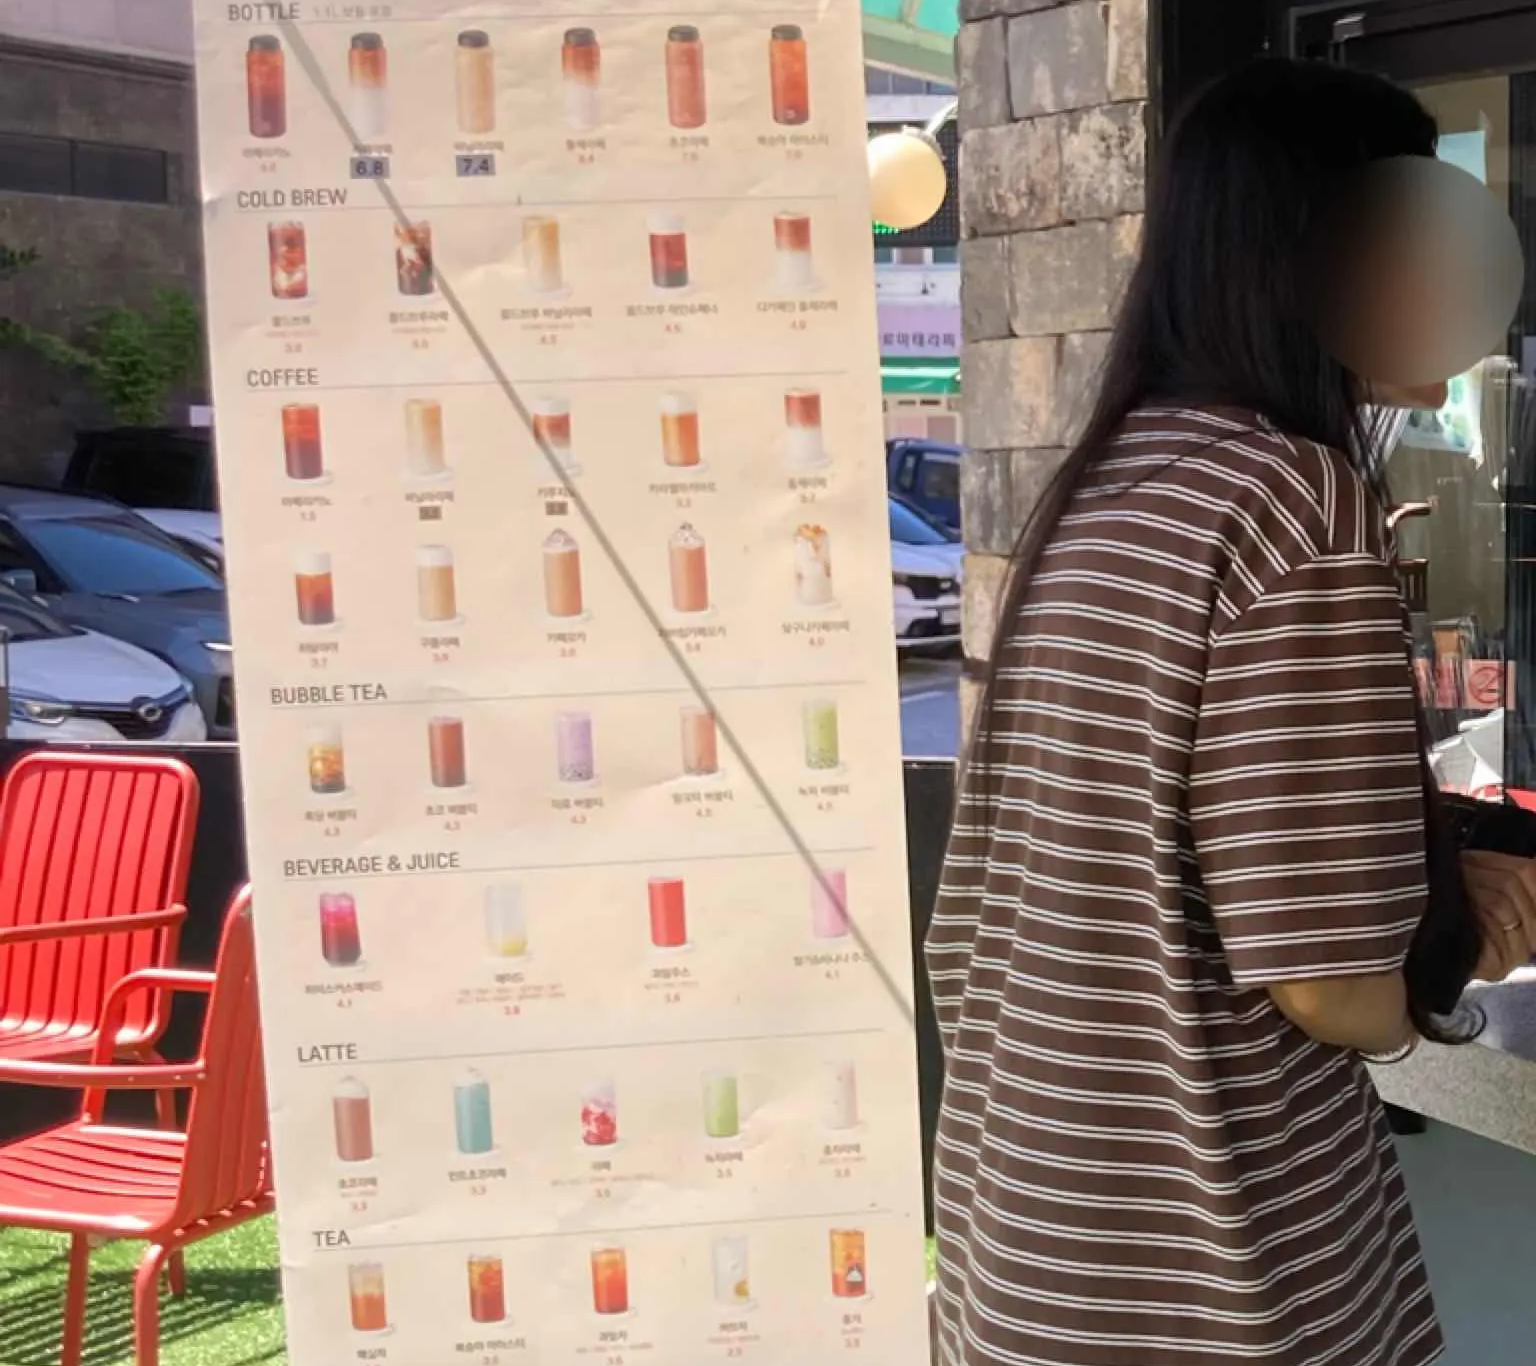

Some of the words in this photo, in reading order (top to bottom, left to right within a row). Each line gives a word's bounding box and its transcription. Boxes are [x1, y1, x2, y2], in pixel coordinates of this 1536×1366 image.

[228, 3, 300, 21] BOTTLE
[356, 160, 384, 176] 6.8
[462, 158, 489, 173] 7.4
[237, 190, 284, 208] COLD
[292, 189, 347, 206] BREW
[247, 368, 320, 387] COFFEE
[272, 686, 345, 704] BUBBLE
[351, 684, 387, 701] TEA
[284, 856, 382, 877] BEVERAGE
[387, 854, 401, 871] &
[406, 852, 460, 870] JUICE
[297, 1043, 357, 1063] LATTE
[313, 1230, 350, 1248] TEA
